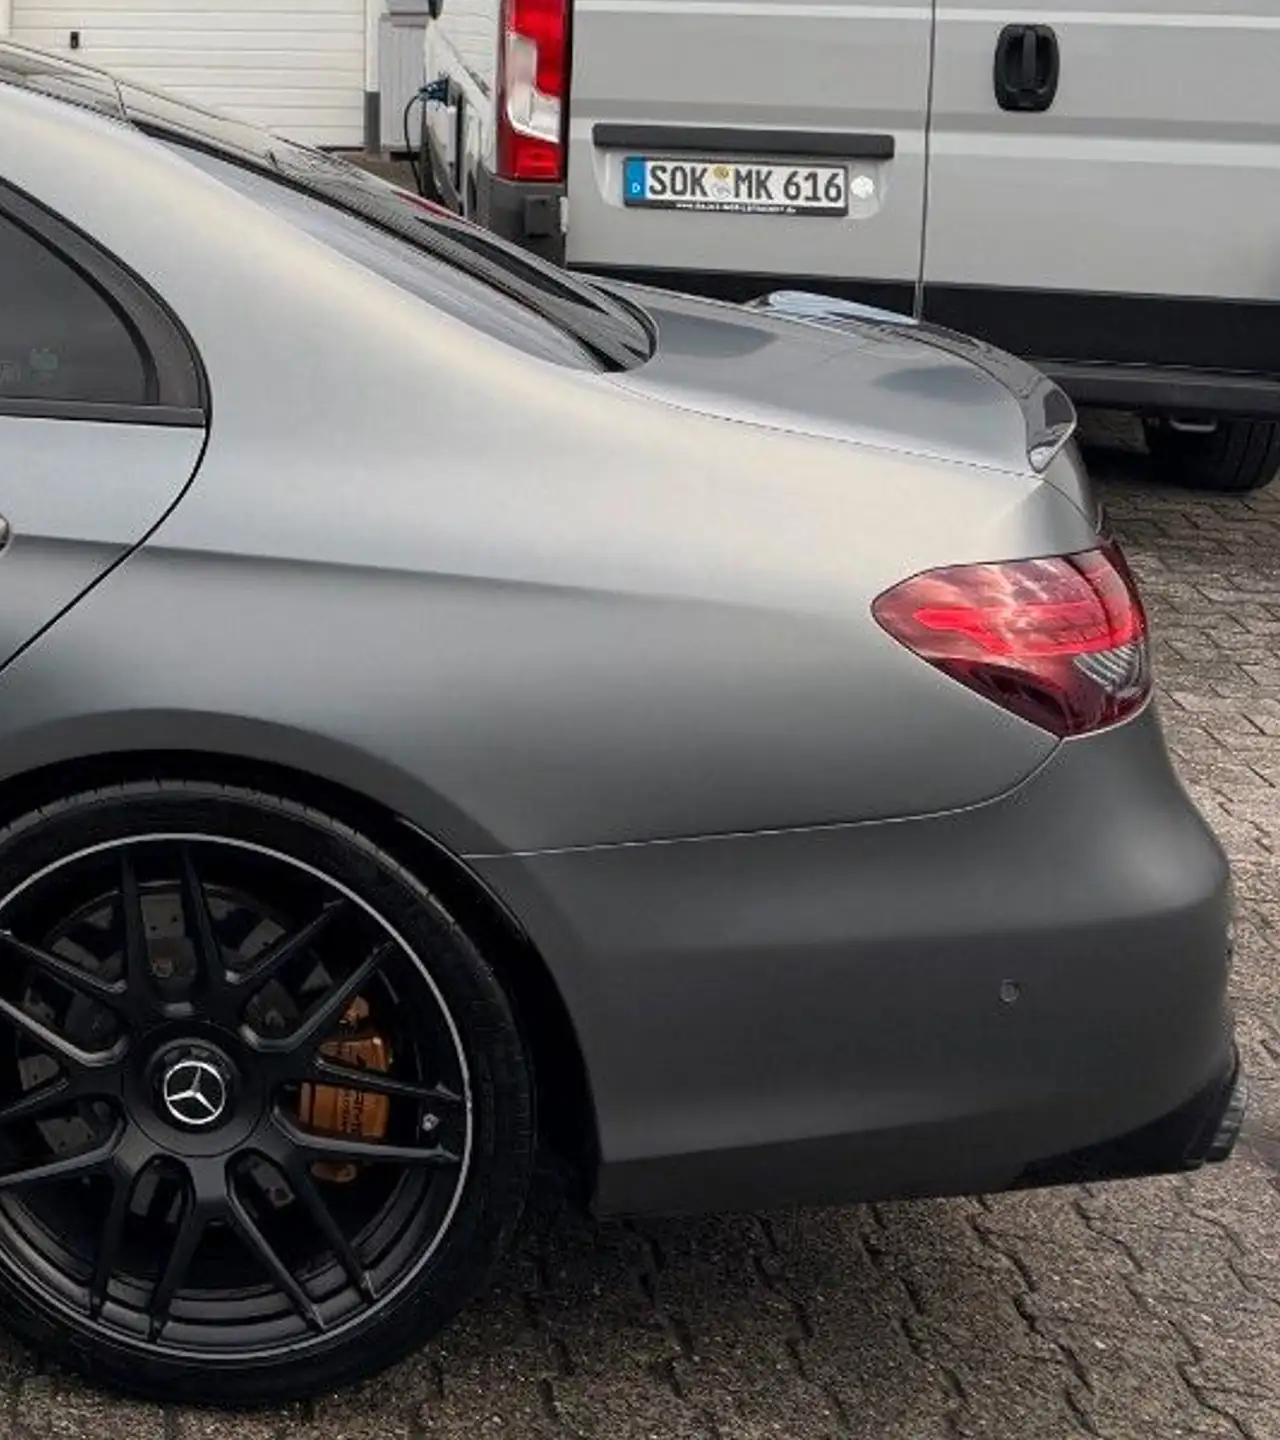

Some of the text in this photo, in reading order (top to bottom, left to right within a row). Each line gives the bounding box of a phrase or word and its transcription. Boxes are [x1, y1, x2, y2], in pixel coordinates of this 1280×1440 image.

[648, 165, 710, 198] SOK
[734, 168, 774, 201] MK
[783, 170, 842, 203] 616
